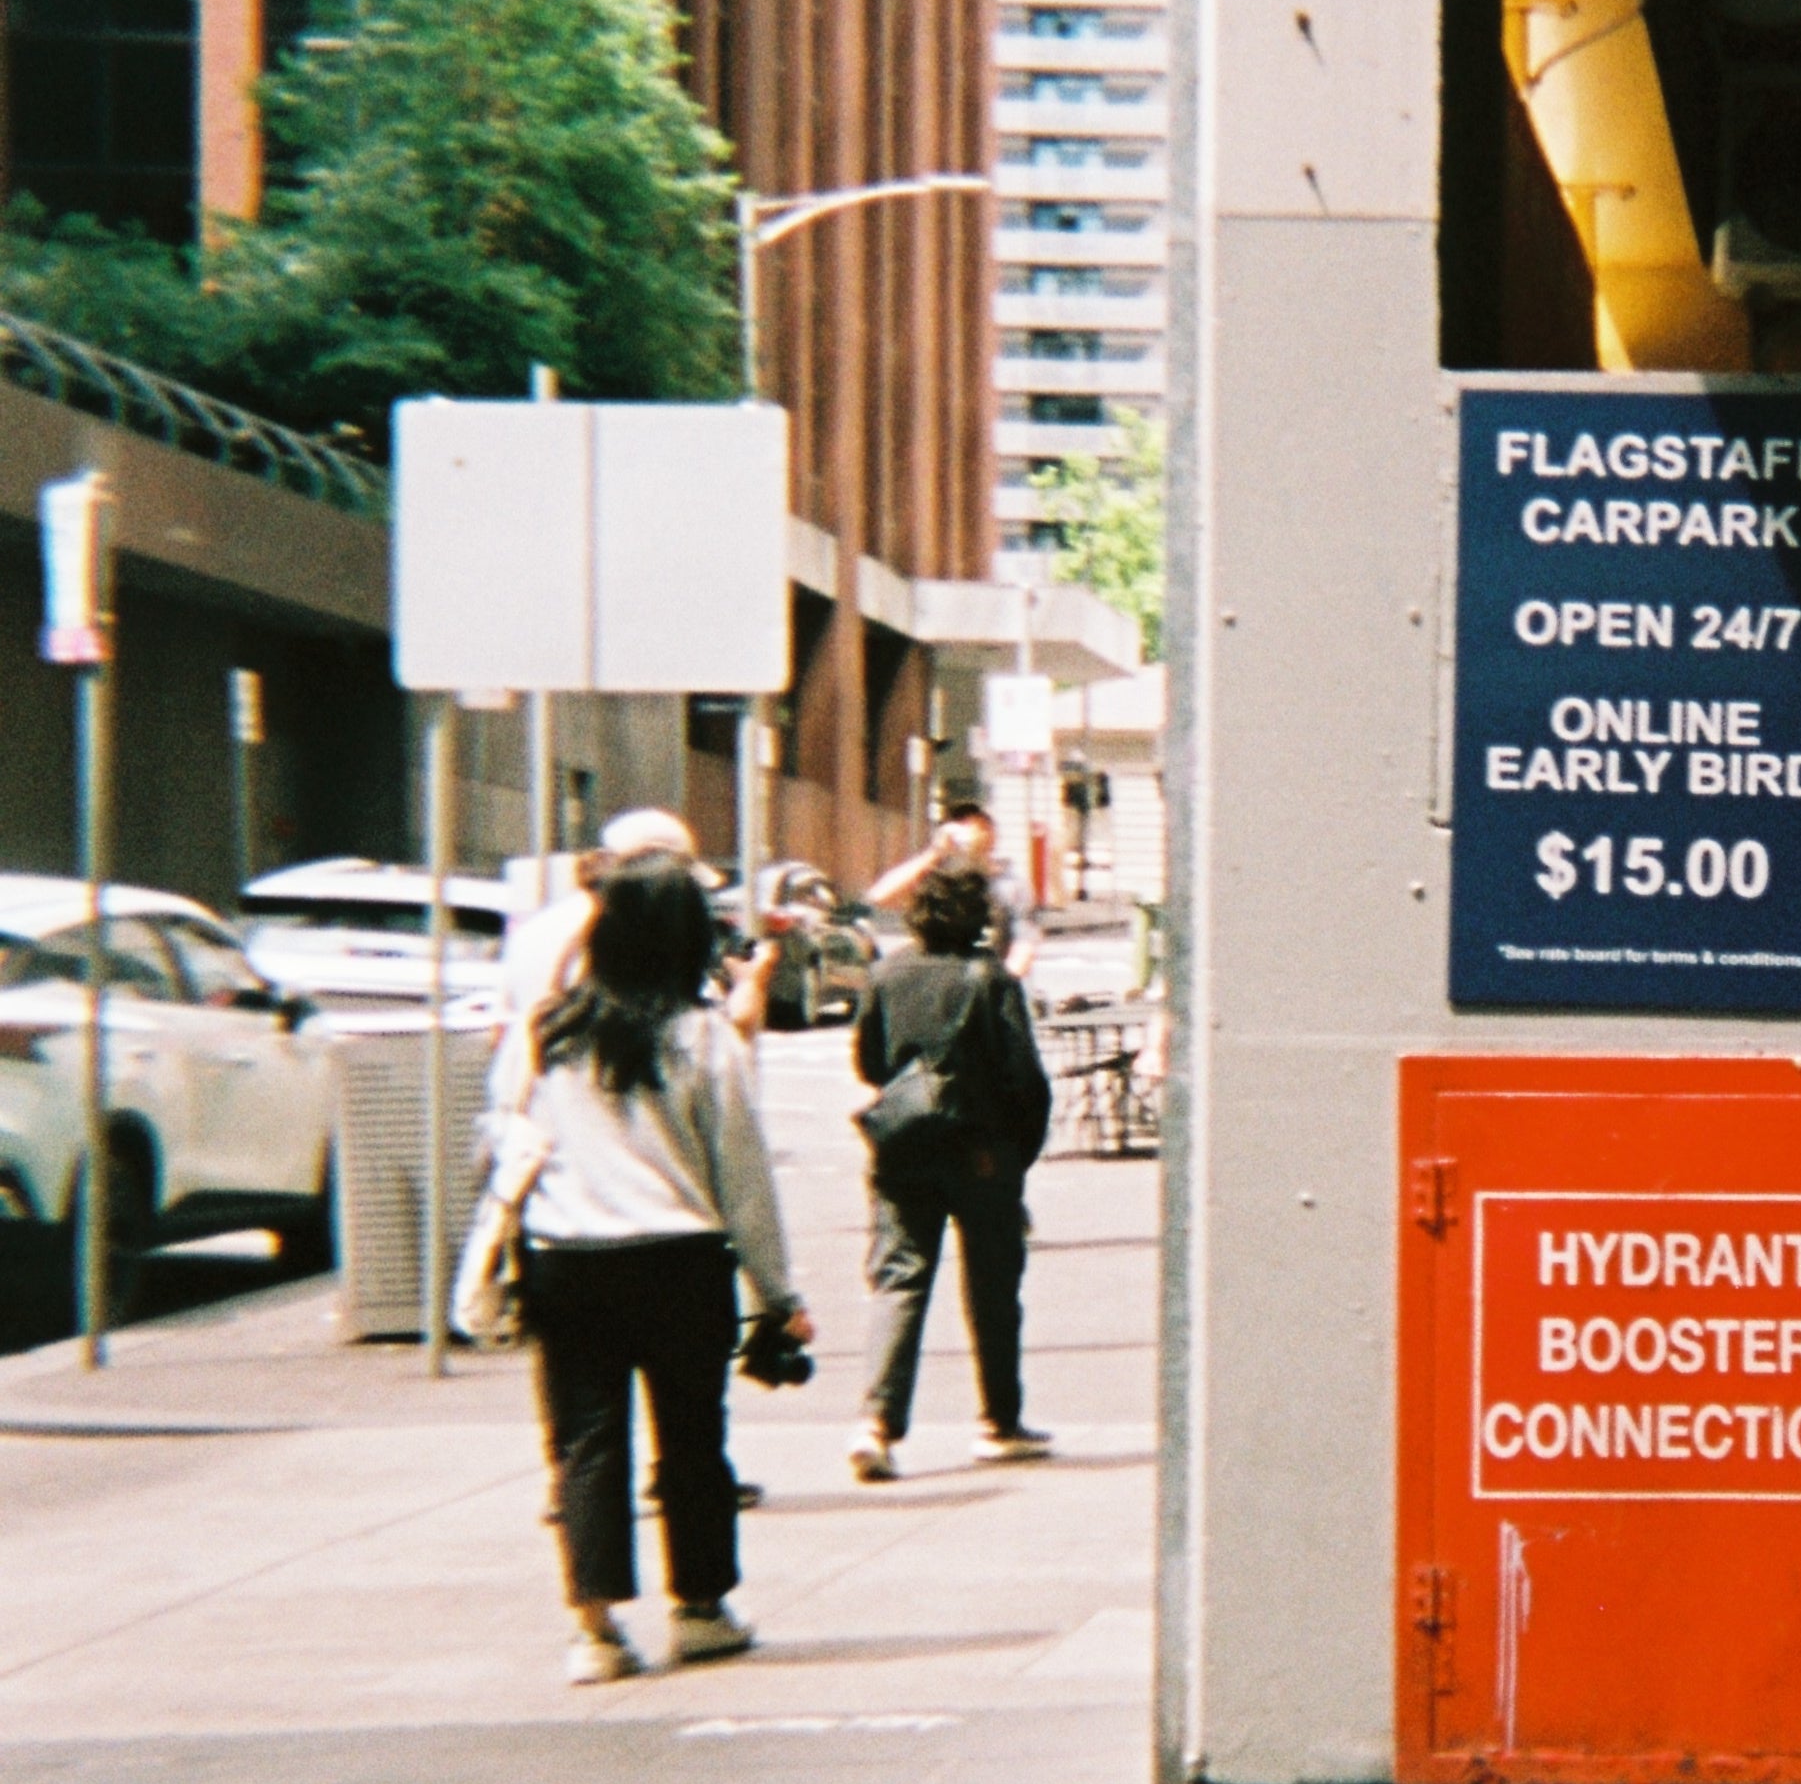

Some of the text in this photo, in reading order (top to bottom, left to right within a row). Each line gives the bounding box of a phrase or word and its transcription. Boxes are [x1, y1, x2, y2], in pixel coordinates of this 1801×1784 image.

[1521, 498, 1801, 548] CARPARK
[1514, 600, 1674, 649] OPEN
[1550, 697, 1761, 746] ONLINE
[1486, 746, 1672, 793] EARLY
[1535, 829, 1770, 900] $15.00
[1573, 947, 1622, 962] board
[1625, 948, 1648, 963] for
[1652, 949, 1698, 965] terms
[1702, 949, 1715, 965] &
